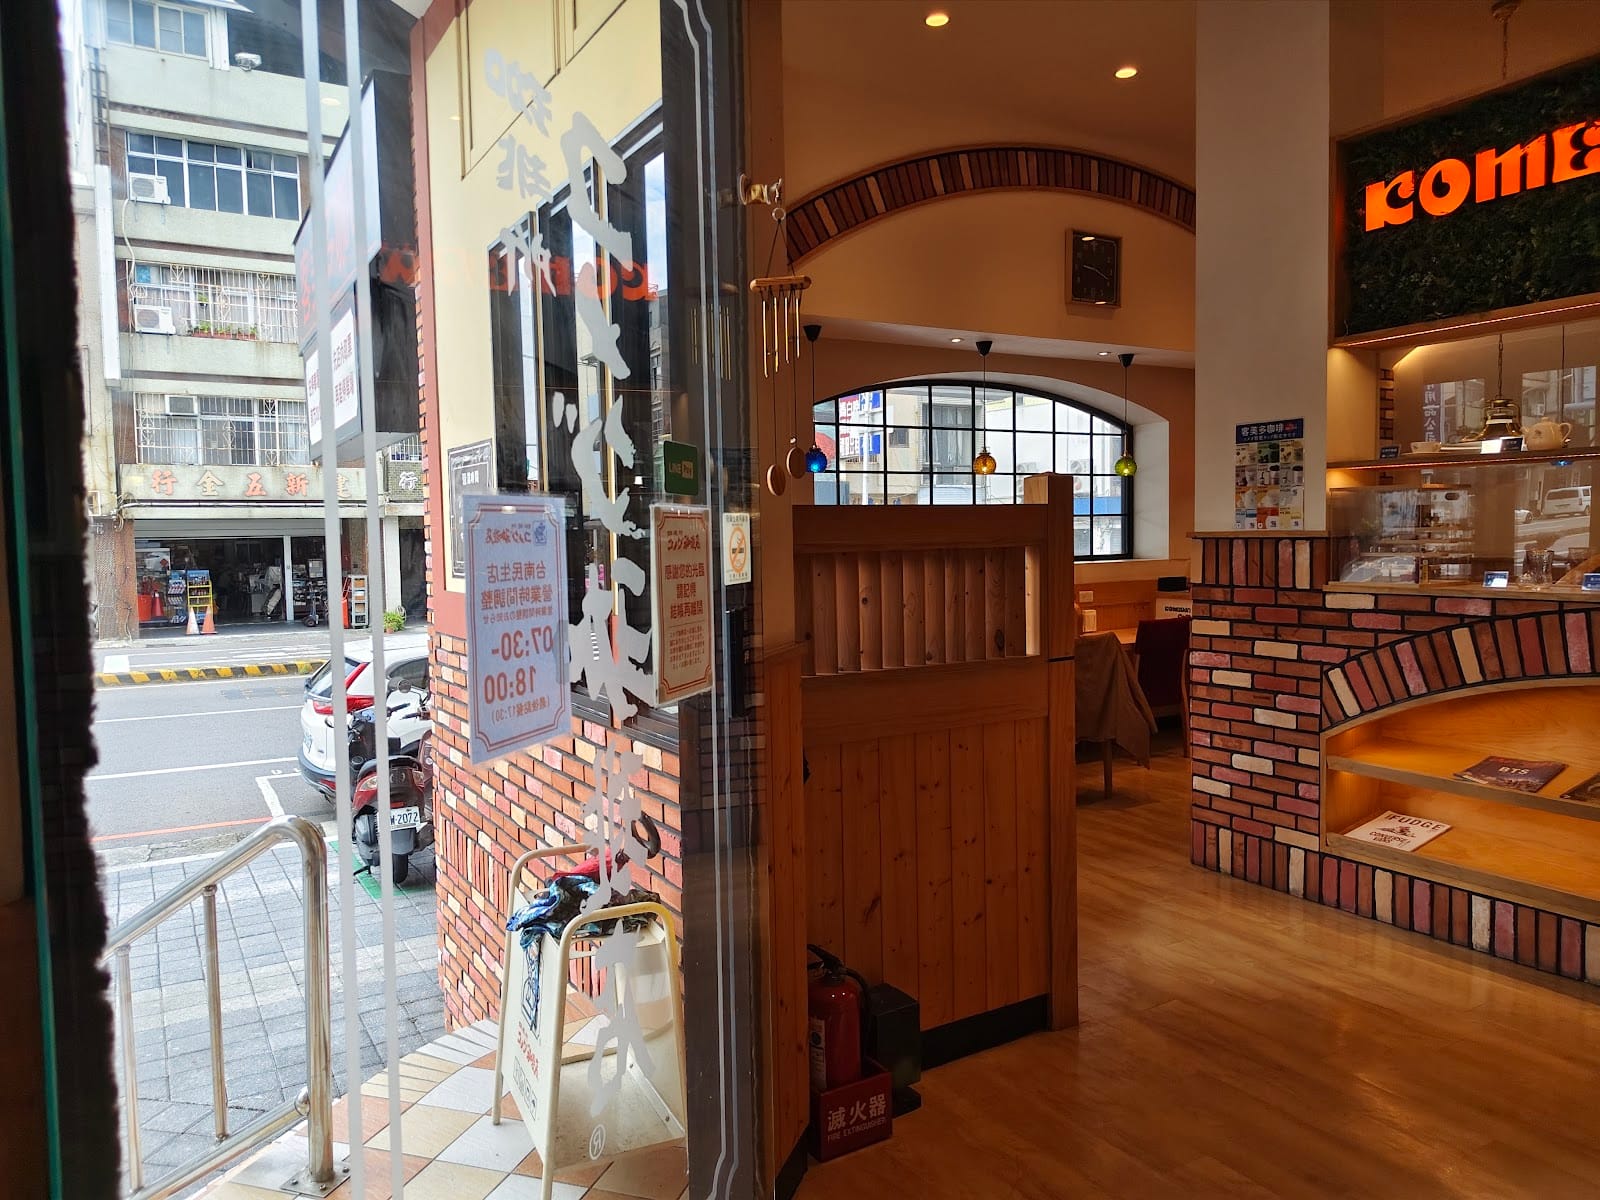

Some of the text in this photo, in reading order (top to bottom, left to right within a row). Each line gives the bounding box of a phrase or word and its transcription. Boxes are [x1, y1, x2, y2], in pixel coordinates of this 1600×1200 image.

[664, 562, 705, 580] 感謝您的光臨
[1498, 765, 1530, 776] BTS
[827, 1093, 887, 1132] 滅火器
